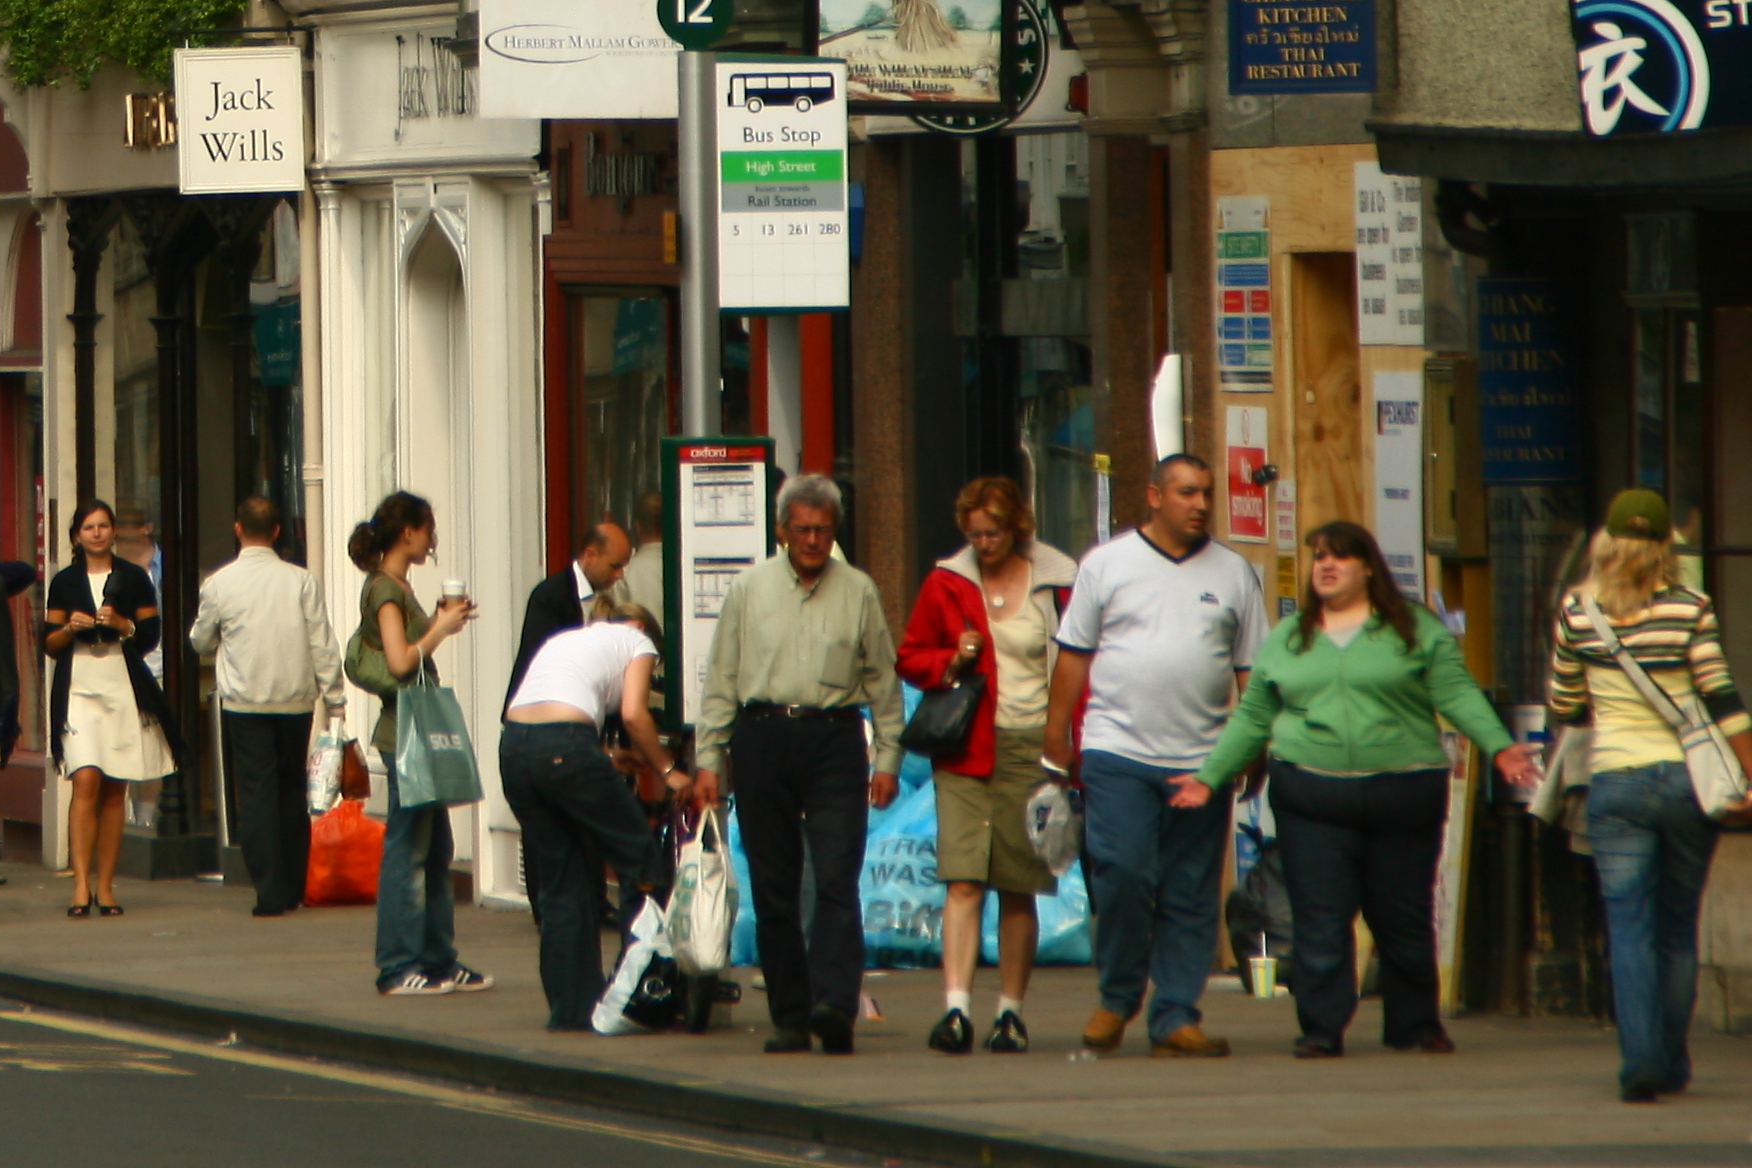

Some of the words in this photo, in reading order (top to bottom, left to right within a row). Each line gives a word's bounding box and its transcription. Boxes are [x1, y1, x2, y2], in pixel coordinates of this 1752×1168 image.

[1257, 6, 1348, 24] KITCHEN
[504, 35, 565, 49] HERBERT
[568, 34, 625, 49] MALLAM
[1280, 47, 1326, 62] THAI
[1246, 62, 1362, 80] RESTAURANT
[205, 78, 275, 121] Jack
[743, 127, 774, 143] Bus
[781, 126, 821, 147] Stop
[200, 129, 284, 163] Wills
[746, 161, 774, 176] High
[779, 160, 816, 172] Street
[748, 195, 770, 207] Rail
[775, 195, 817, 207] Station
[733, 225, 741, 236] 5
[762, 224, 775, 236] 13
[788, 223, 808, 235] 261
[819, 223, 841, 235] 280
[691, 446, 726, 458] oxford
[871, 863, 938, 886] WAS
